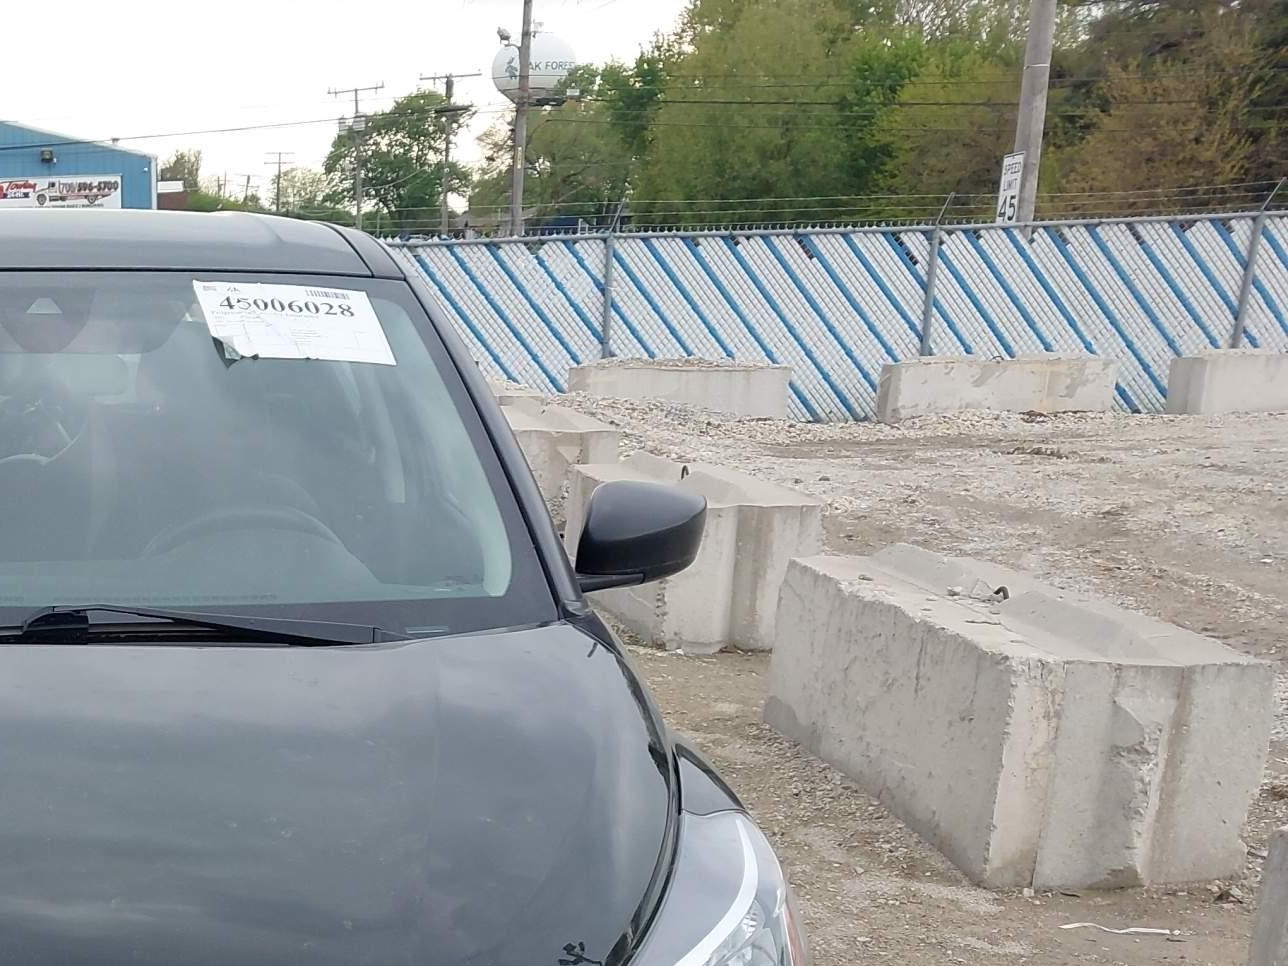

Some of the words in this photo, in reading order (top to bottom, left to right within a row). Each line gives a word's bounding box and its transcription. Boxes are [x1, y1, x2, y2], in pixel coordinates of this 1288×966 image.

[1004, 162, 1022, 175] SPEED
[1003, 178, 1018, 191] LIMIT
[998, 195, 1016, 221] 45
[219, 295, 355, 317] 45006028
